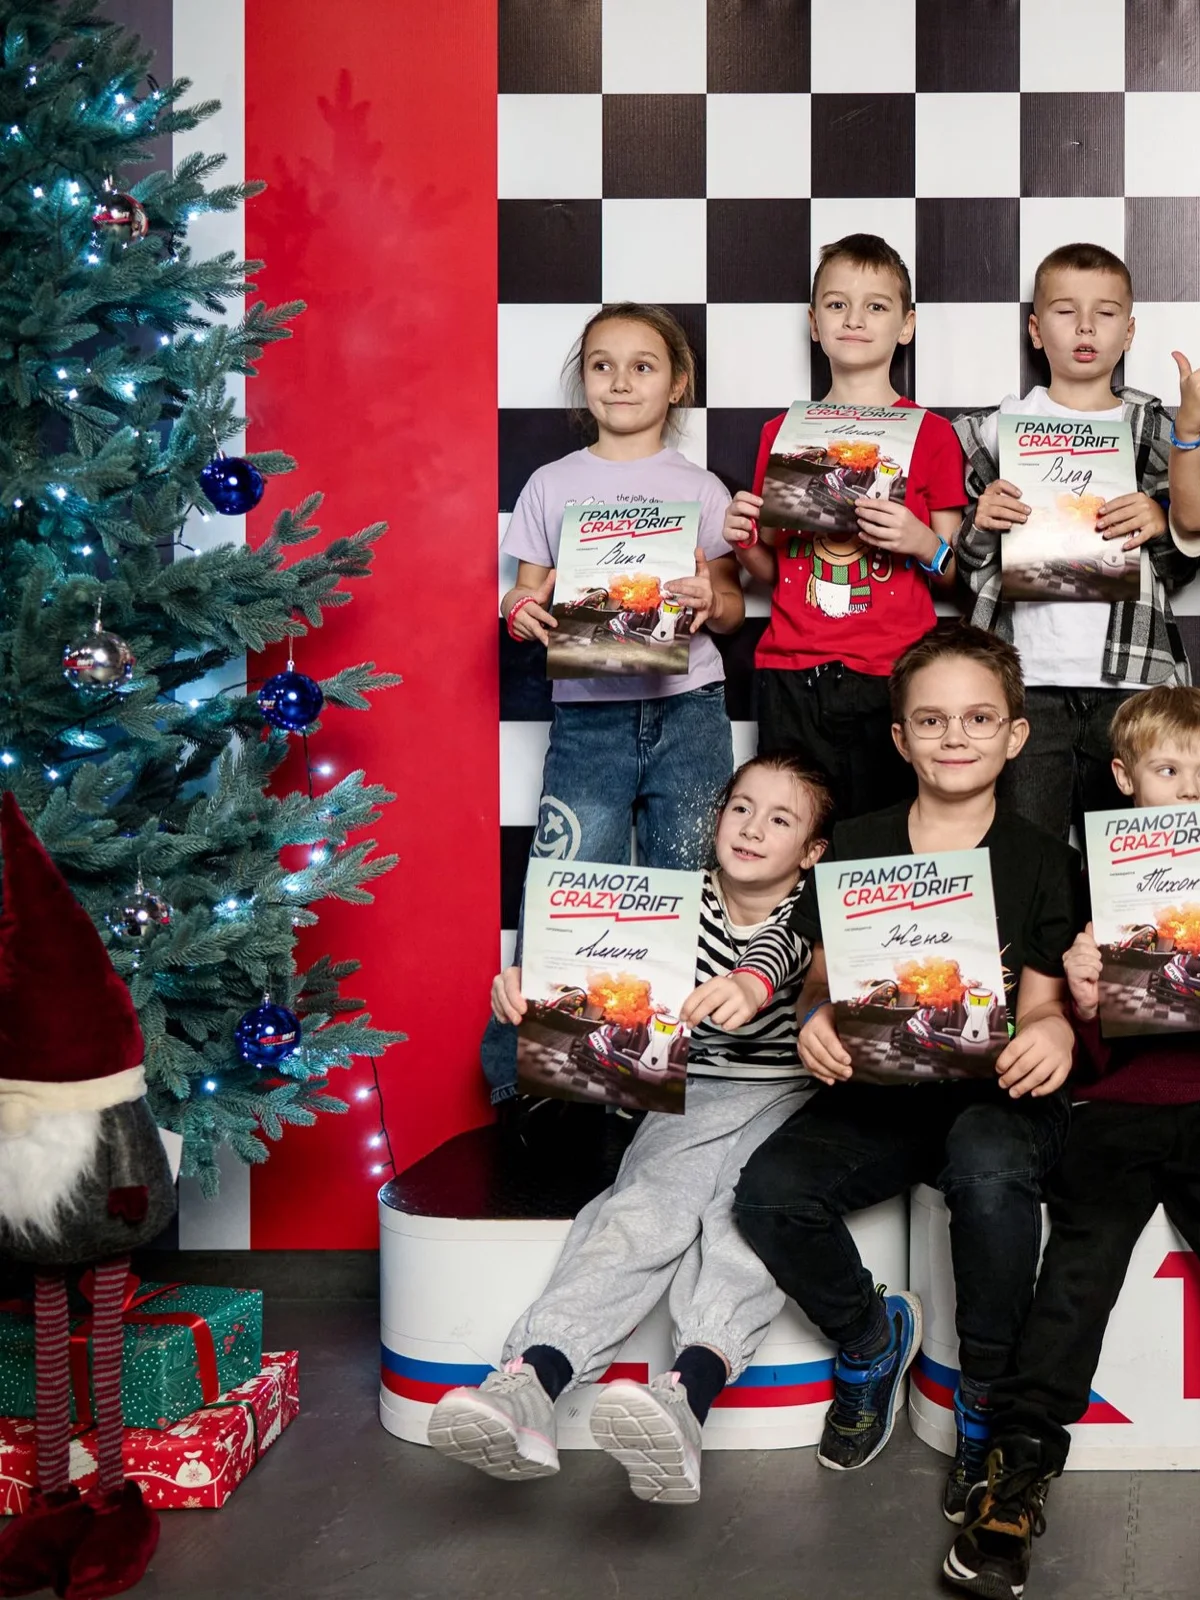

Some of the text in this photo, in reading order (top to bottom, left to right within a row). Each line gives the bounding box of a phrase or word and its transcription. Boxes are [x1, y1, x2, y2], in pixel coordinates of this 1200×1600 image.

[806, 403, 885, 412] ГРАМОТА
[806, 409, 911, 419] CRAZYDRIFT
[1015, 422, 1093, 435] ГРАМОТА
[1018, 435, 1120, 448] CRAZYDRIFT
[1041, 456, 1093, 497] Влад
[579, 507, 660, 522] ГРАМОТА
[580, 515, 686, 534] CRAZYDRIFT
[596, 541, 646, 566] Вика
[1105, 811, 1198, 836] ГРАМОТА
[547, 871, 649, 893] ГРАМОТА
[837, 861, 938, 889] ГРАМОТА
[1136, 867, 1200, 893] Тихон
[549, 889, 684, 913] CRAZYDRIFT
[843, 875, 973, 907] CRAZYDRIFT
[881, 924, 952, 947] Женя
